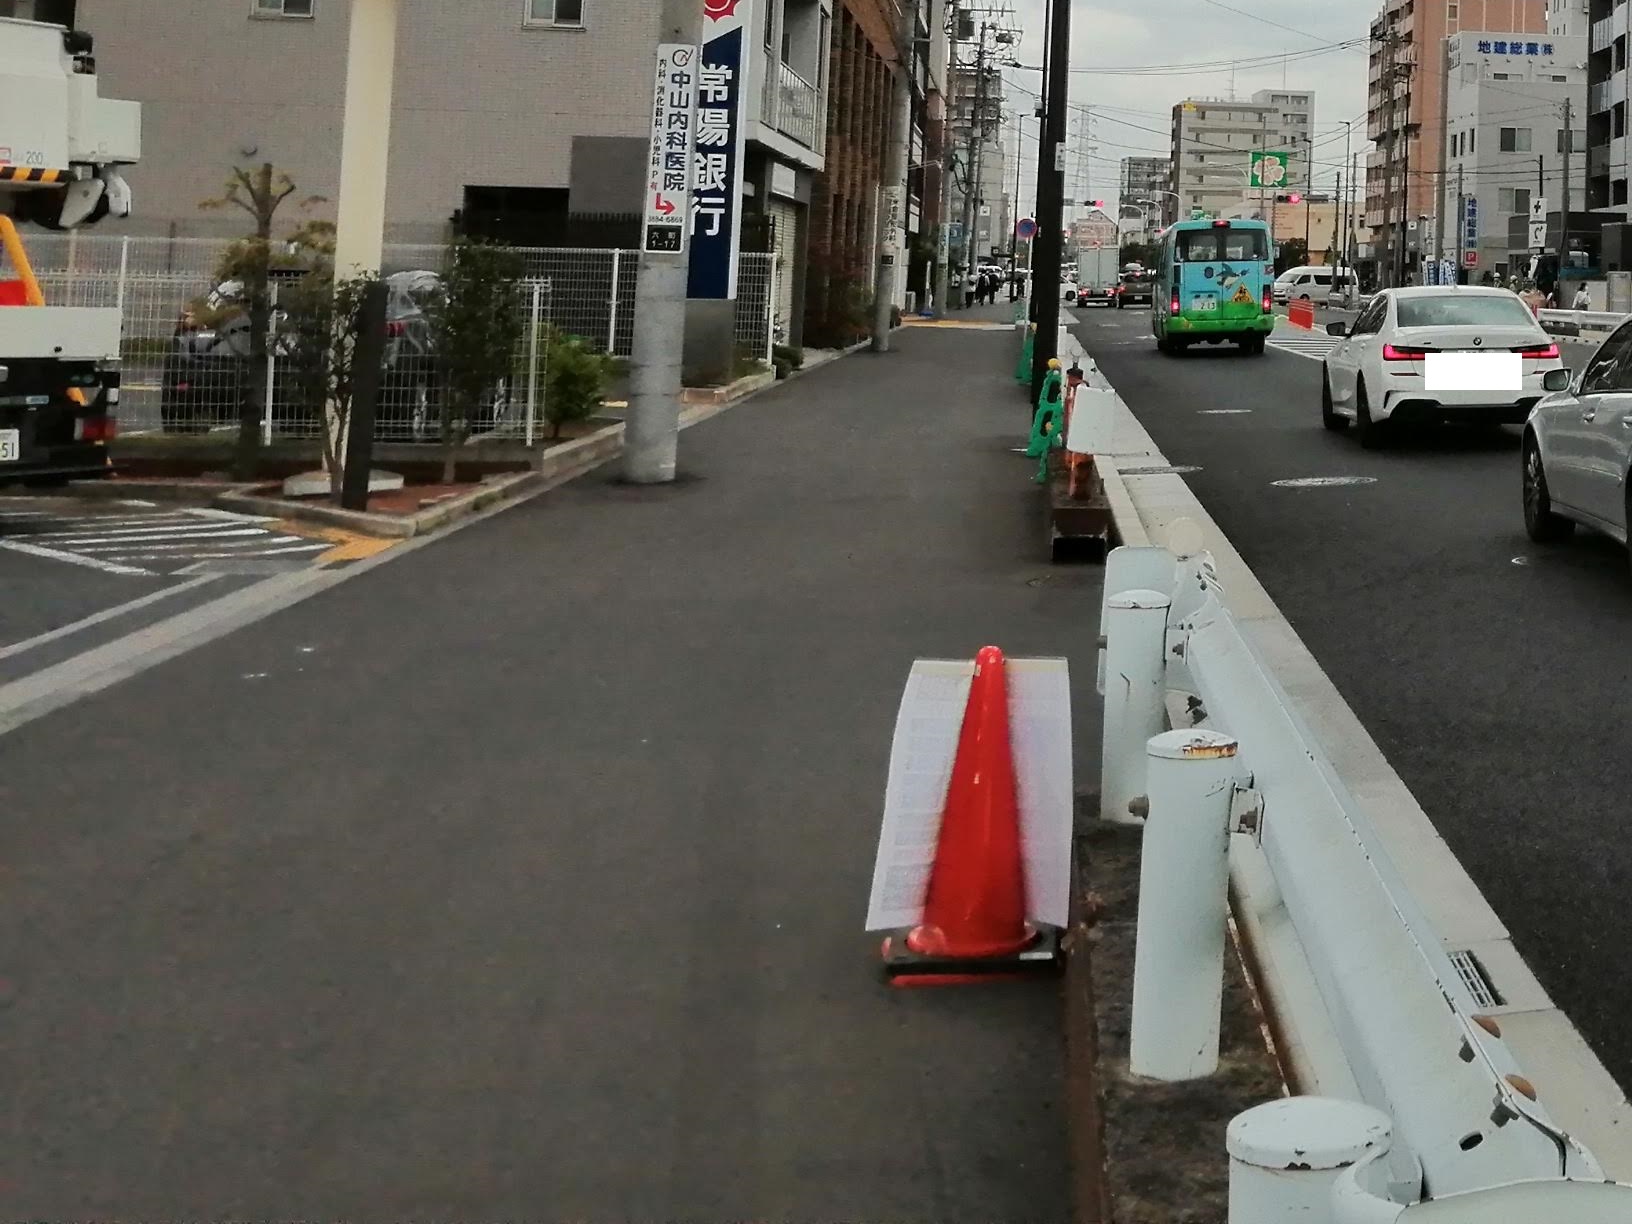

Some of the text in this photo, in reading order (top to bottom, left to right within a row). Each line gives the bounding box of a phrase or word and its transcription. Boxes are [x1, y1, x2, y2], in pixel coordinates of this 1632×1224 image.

[663, 70, 691, 192] 中山内科医院
[690, 63, 733, 236] 常陽銀行
